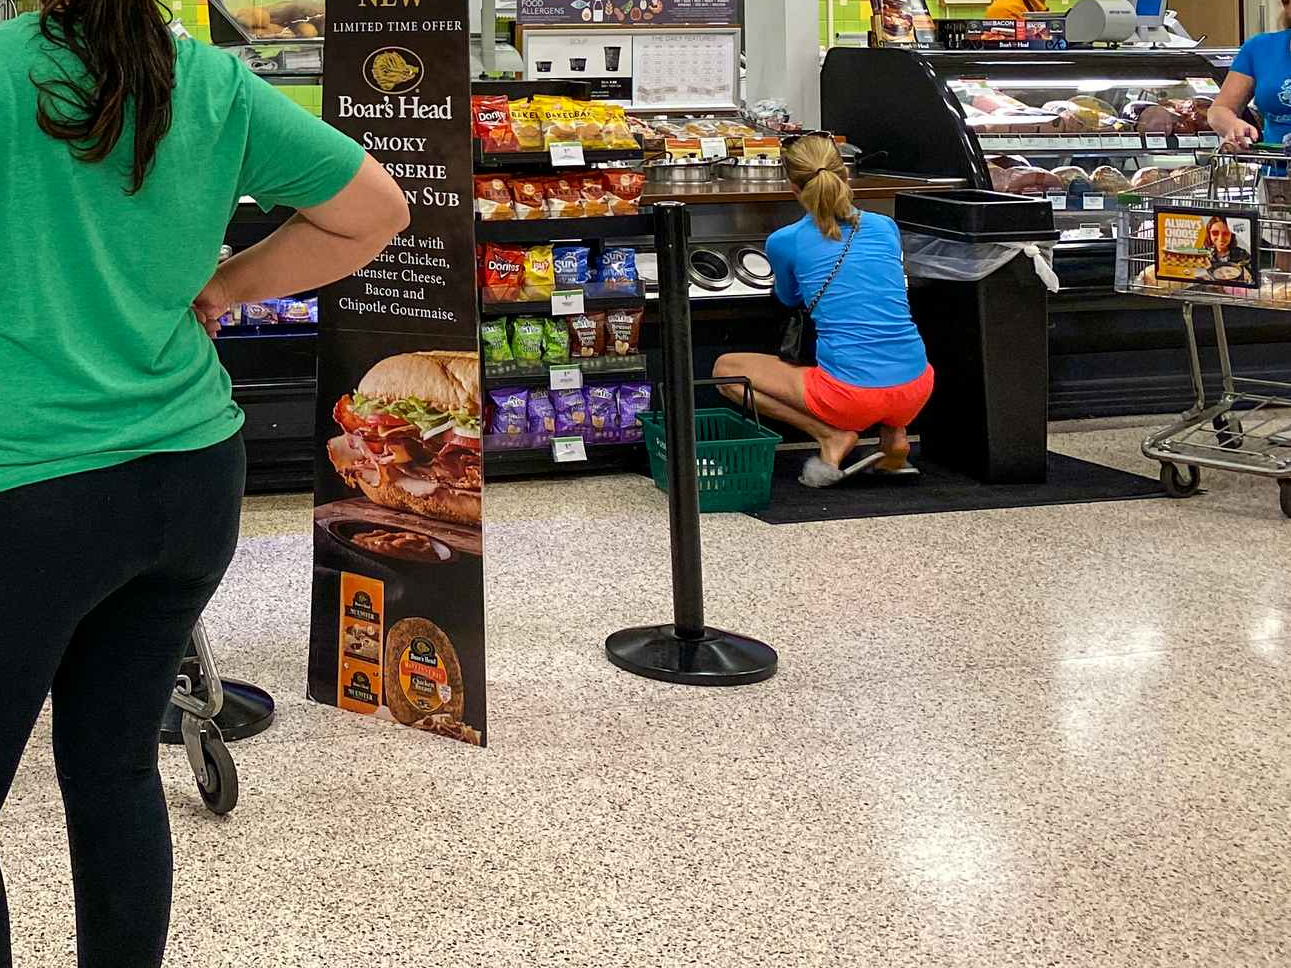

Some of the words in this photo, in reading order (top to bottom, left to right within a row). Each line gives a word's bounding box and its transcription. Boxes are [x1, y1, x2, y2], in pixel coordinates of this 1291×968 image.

[521, 0, 544, 7] FOOD
[521, 7, 565, 15] ALLERGENS
[333, 21, 383, 33] LIMITED
[387, 21, 418, 32] TIME
[422, 20, 462, 31] OFFER
[338, 95, 393, 118] Boar's
[398, 95, 452, 120] Head
[1164, 217, 1202, 229] ALWAYS
[418, 236, 445, 250] with
[398, 251, 450, 269] Chicken,
[488, 261, 520, 273] Doritos
[401, 269, 446, 286] Cheese,
[365, 283, 400, 298] Bacon
[403, 287, 425, 300] and
[338, 297, 387, 314] Chipotle
[390, 303, 458, 322] Gourmaise.
